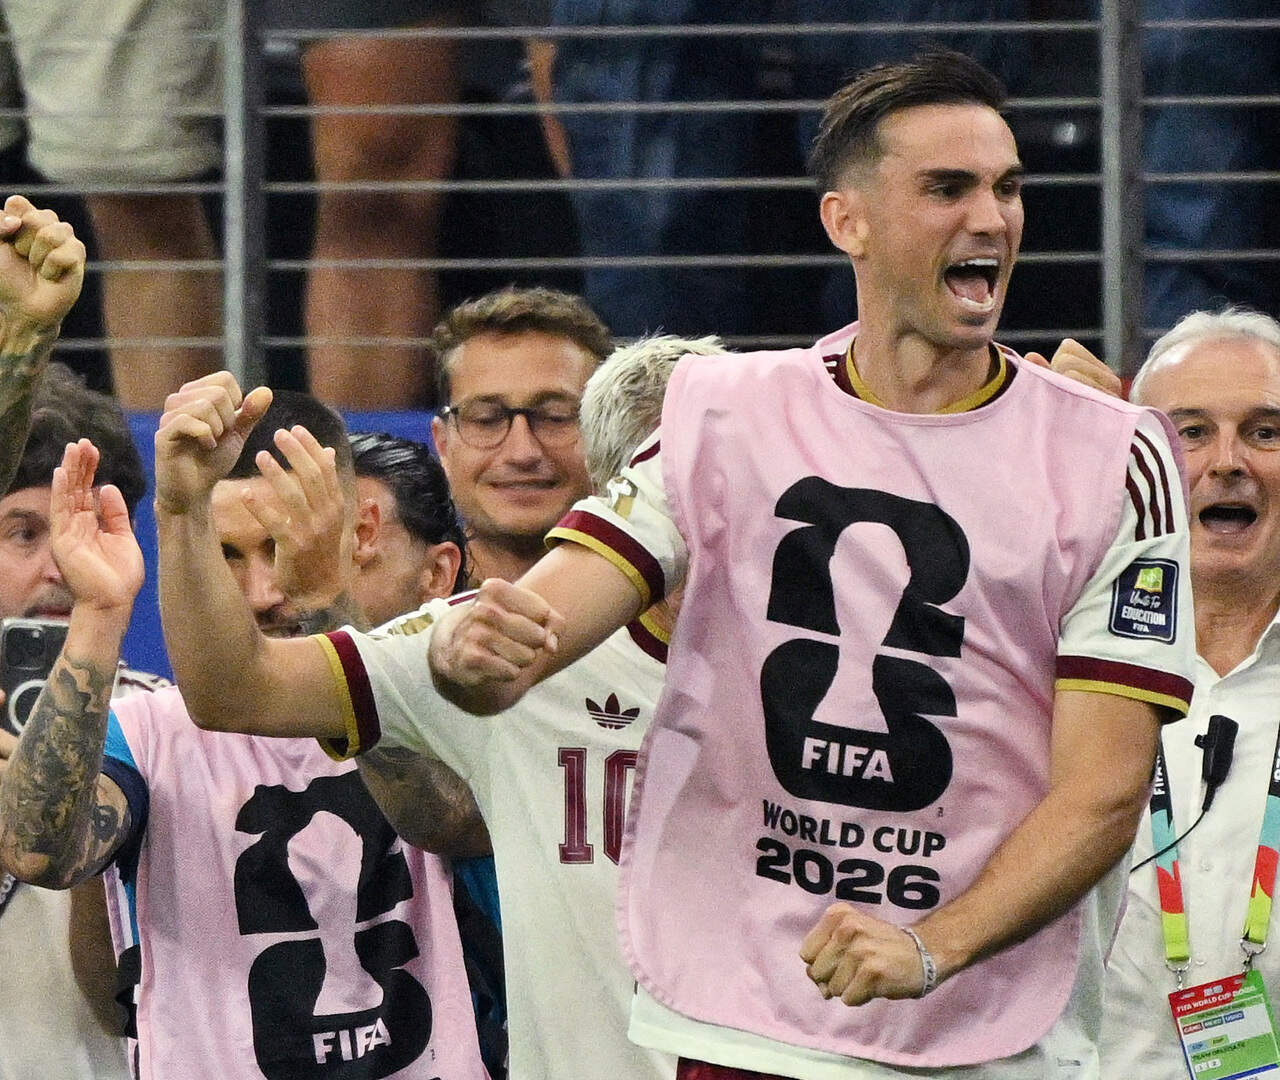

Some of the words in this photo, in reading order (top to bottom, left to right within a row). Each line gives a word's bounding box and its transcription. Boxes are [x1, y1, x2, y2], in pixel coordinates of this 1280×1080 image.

[1121, 606, 1166, 625] EDUCATION
[1133, 623, 1149, 632] FIFA
[801, 736, 894, 783] FIFA
[762, 800, 865, 848] WORLD
[872, 826, 946, 858] CUP
[756, 838, 941, 910] 2026
[1192, 998, 1217, 1008] WORLD
[312, 1017, 392, 1064] FIFA
